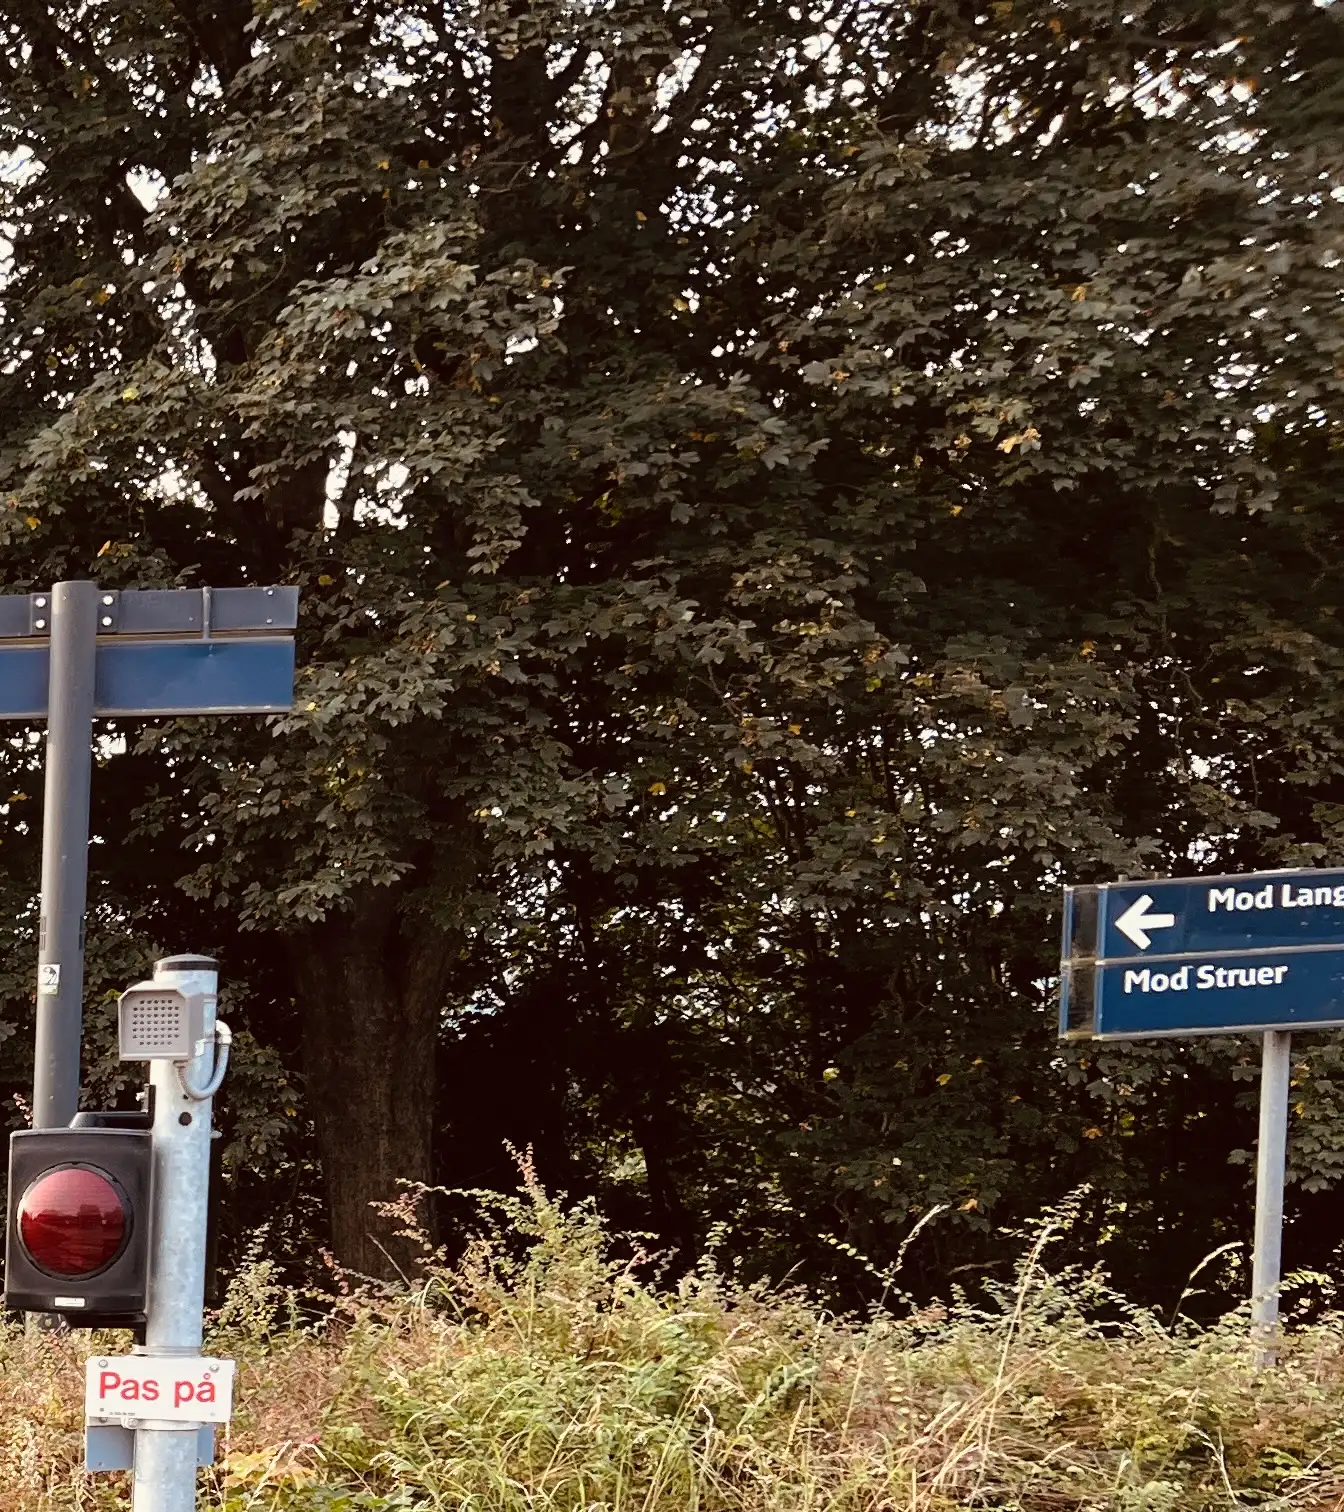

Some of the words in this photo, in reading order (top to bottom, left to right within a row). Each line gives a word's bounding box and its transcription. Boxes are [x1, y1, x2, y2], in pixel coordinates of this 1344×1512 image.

[1208, 884, 1274, 912] Mod
[1124, 966, 1189, 994] Mod
[1195, 964, 1289, 990] Struer
[99, 1371, 160, 1401] Pas
[174, 1372, 216, 1408] på
